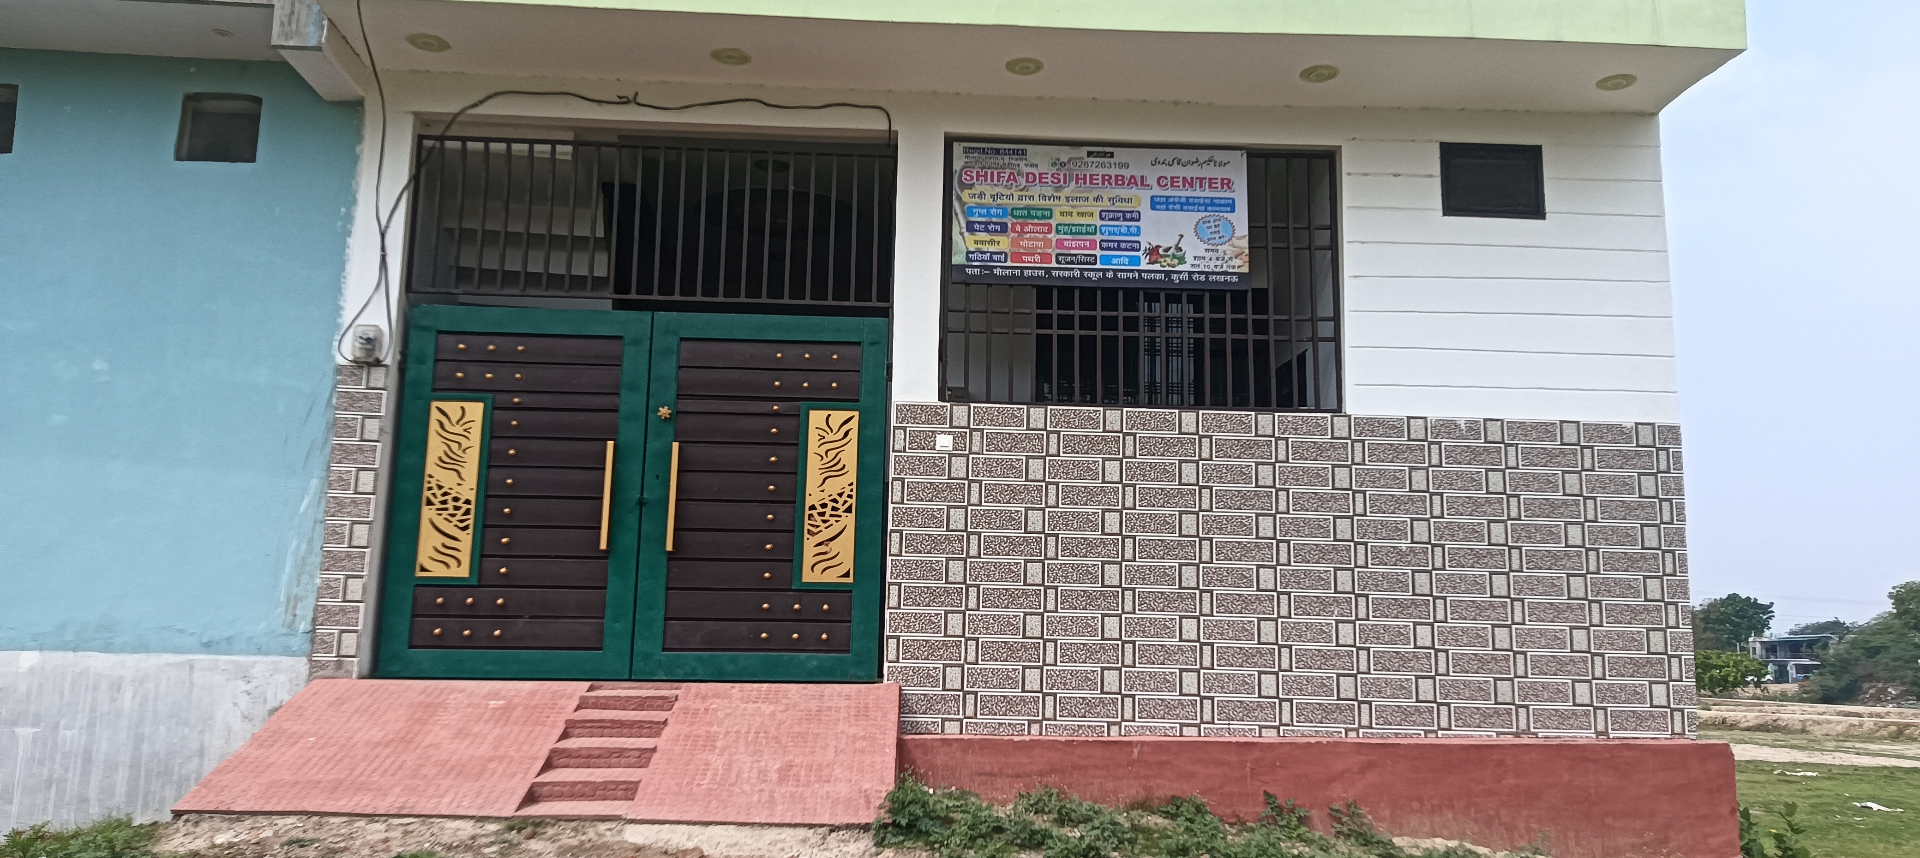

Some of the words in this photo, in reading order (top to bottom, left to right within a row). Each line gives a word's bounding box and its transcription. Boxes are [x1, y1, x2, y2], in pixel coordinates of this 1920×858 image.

[962, 168, 1020, 185] SHIFA
[1024, 170, 1069, 187] DESI
[1074, 172, 1152, 189] HERBAL
[1156, 174, 1235, 192] CENTER
[1064, 195, 1089, 204] इलाज
[1092, 194, 1104, 204] की
[1107, 195, 1133, 206] सुविधा
[990, 207, 1003, 216] रोग
[1076, 211, 1094, 219] खाज
[1125, 211, 1139, 220] कमी
[973, 223, 986, 232] पेट
[987, 223, 1001, 232] रोग
[1019, 239, 1044, 248] मोटापा
[1101, 241, 1118, 249] कमर
[1022, 254, 1041, 263] पथरी
[1110, 256, 1130, 265] आदि
[1051, 268, 1081, 278] सरकारी
[1083, 271, 1103, 280] स्कूल
[1105, 270, 1114, 279] के
[1116, 270, 1139, 280] सामने
[1191, 272, 1206, 282] रोड
[1208, 274, 1239, 283] लखनऊ
